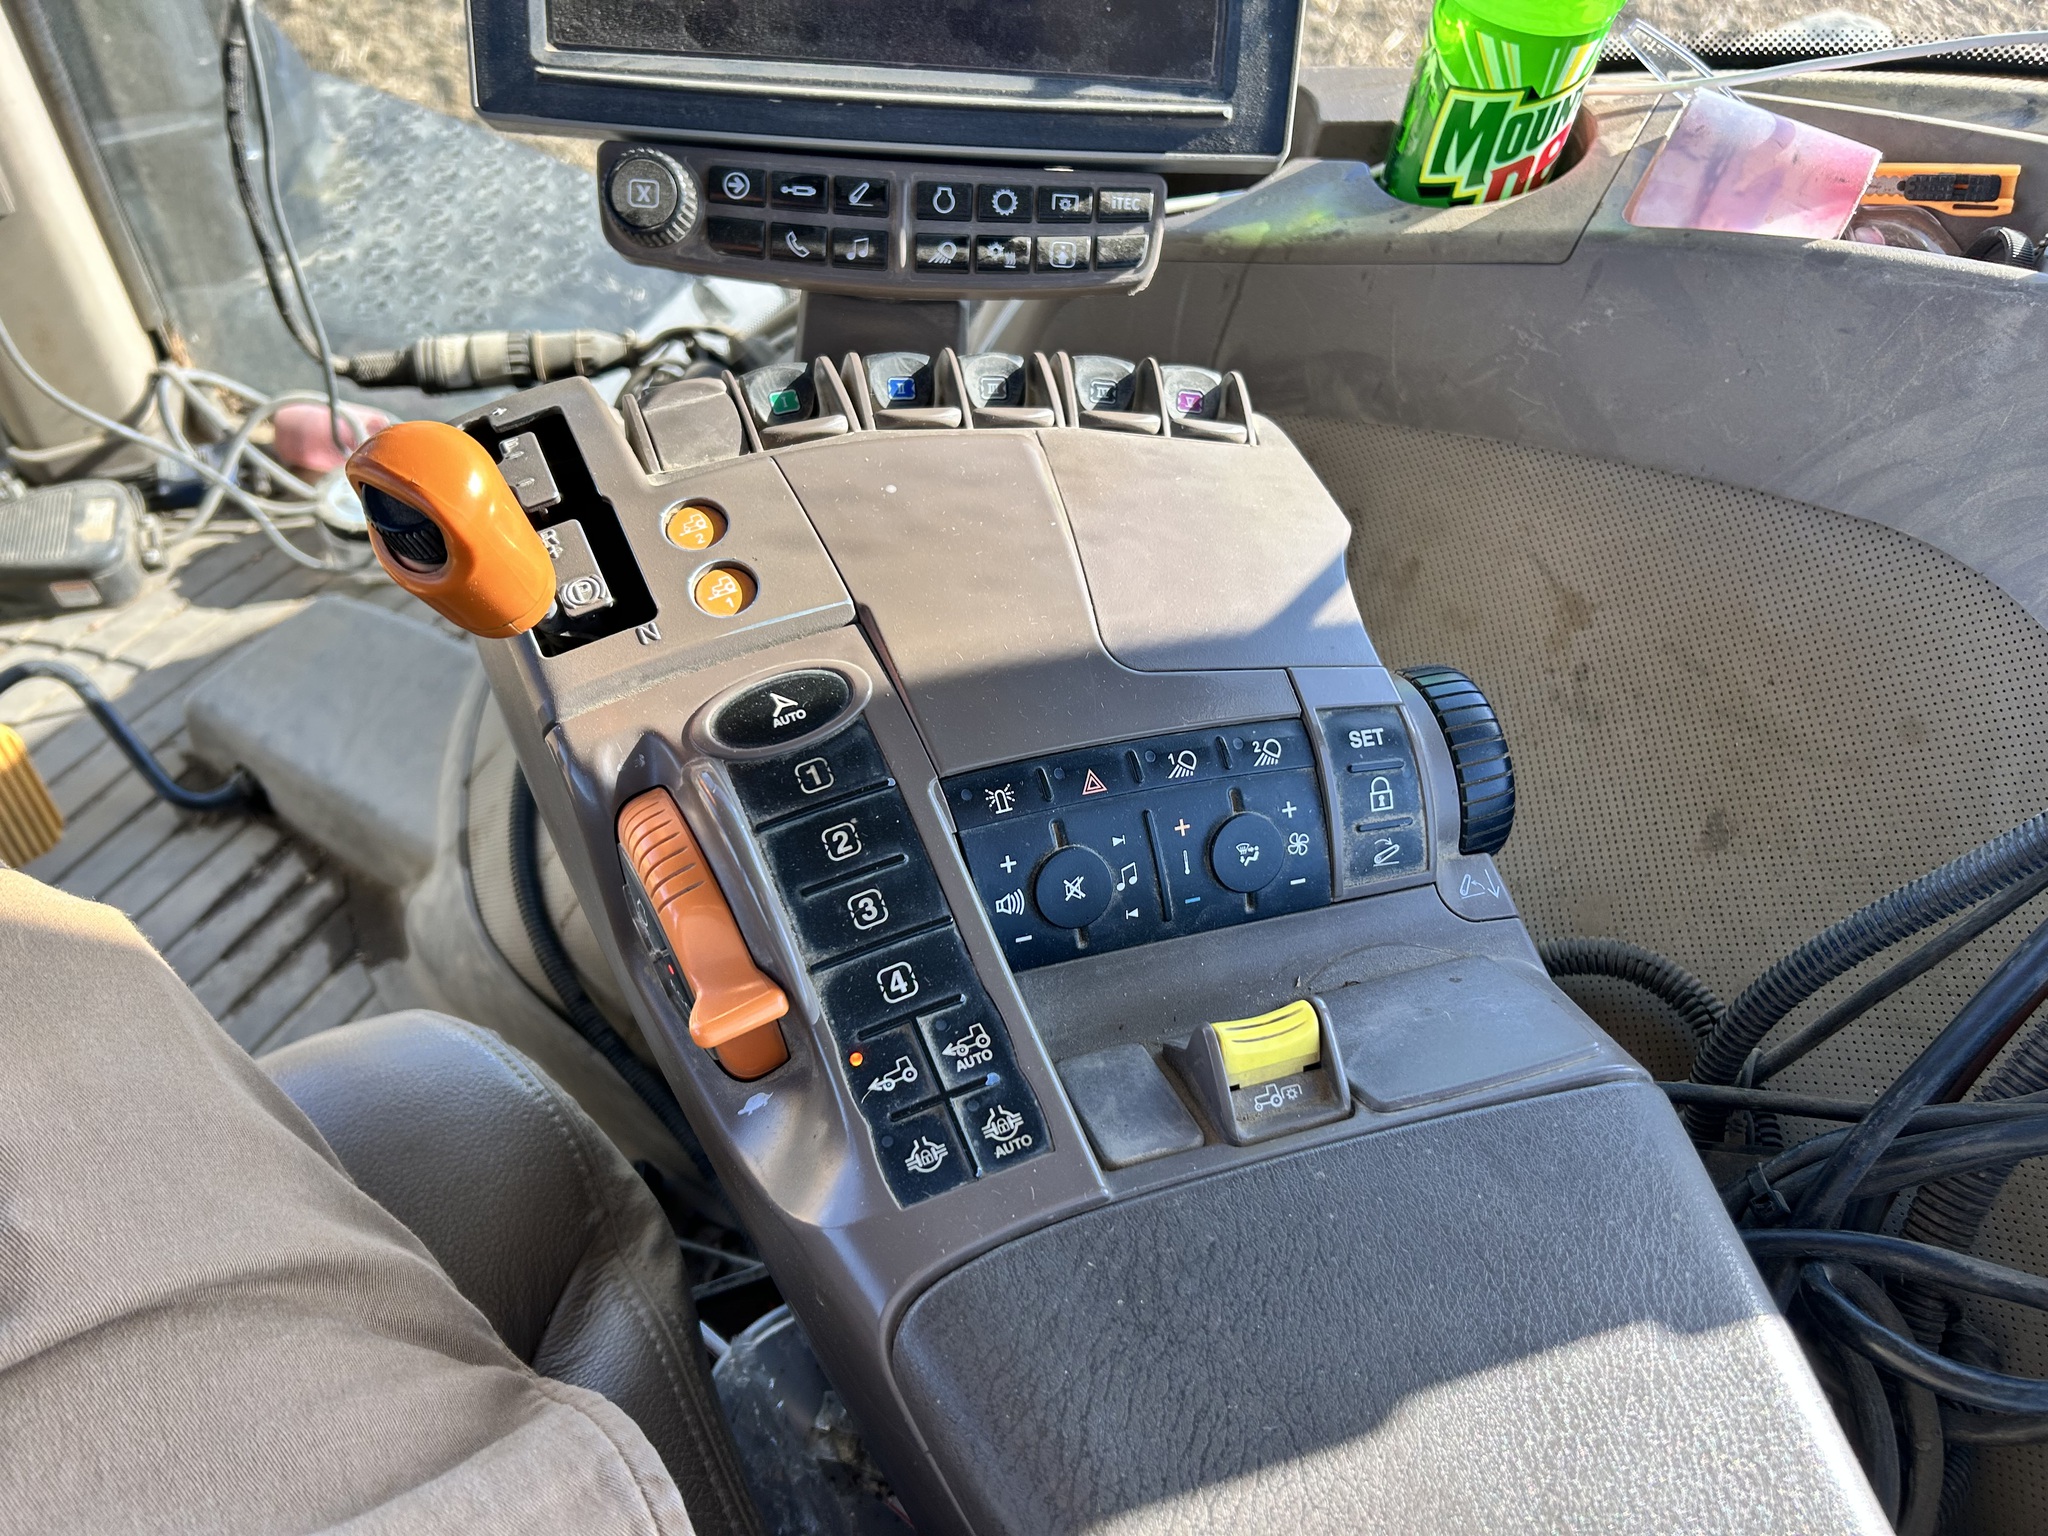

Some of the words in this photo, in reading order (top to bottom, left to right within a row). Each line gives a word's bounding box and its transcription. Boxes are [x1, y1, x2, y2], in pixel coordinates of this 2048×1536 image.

[636, 184, 651, 203] X
[1111, 195, 1141, 211] iTEC
[695, 533, 706, 545] 2
[726, 597, 734, 607] 1
[772, 708, 807, 729] AUTO
[1252, 741, 1261, 753] 2
[1349, 727, 1385, 749] SET
[1168, 753, 1175, 765] 1
[805, 765, 823, 786] 1
[831, 830, 853, 855] 2
[857, 897, 879, 921] 3
[889, 969, 908, 994] 4
[956, 1049, 993, 1073] AUTO
[994, 1134, 1033, 1159] AUTO
